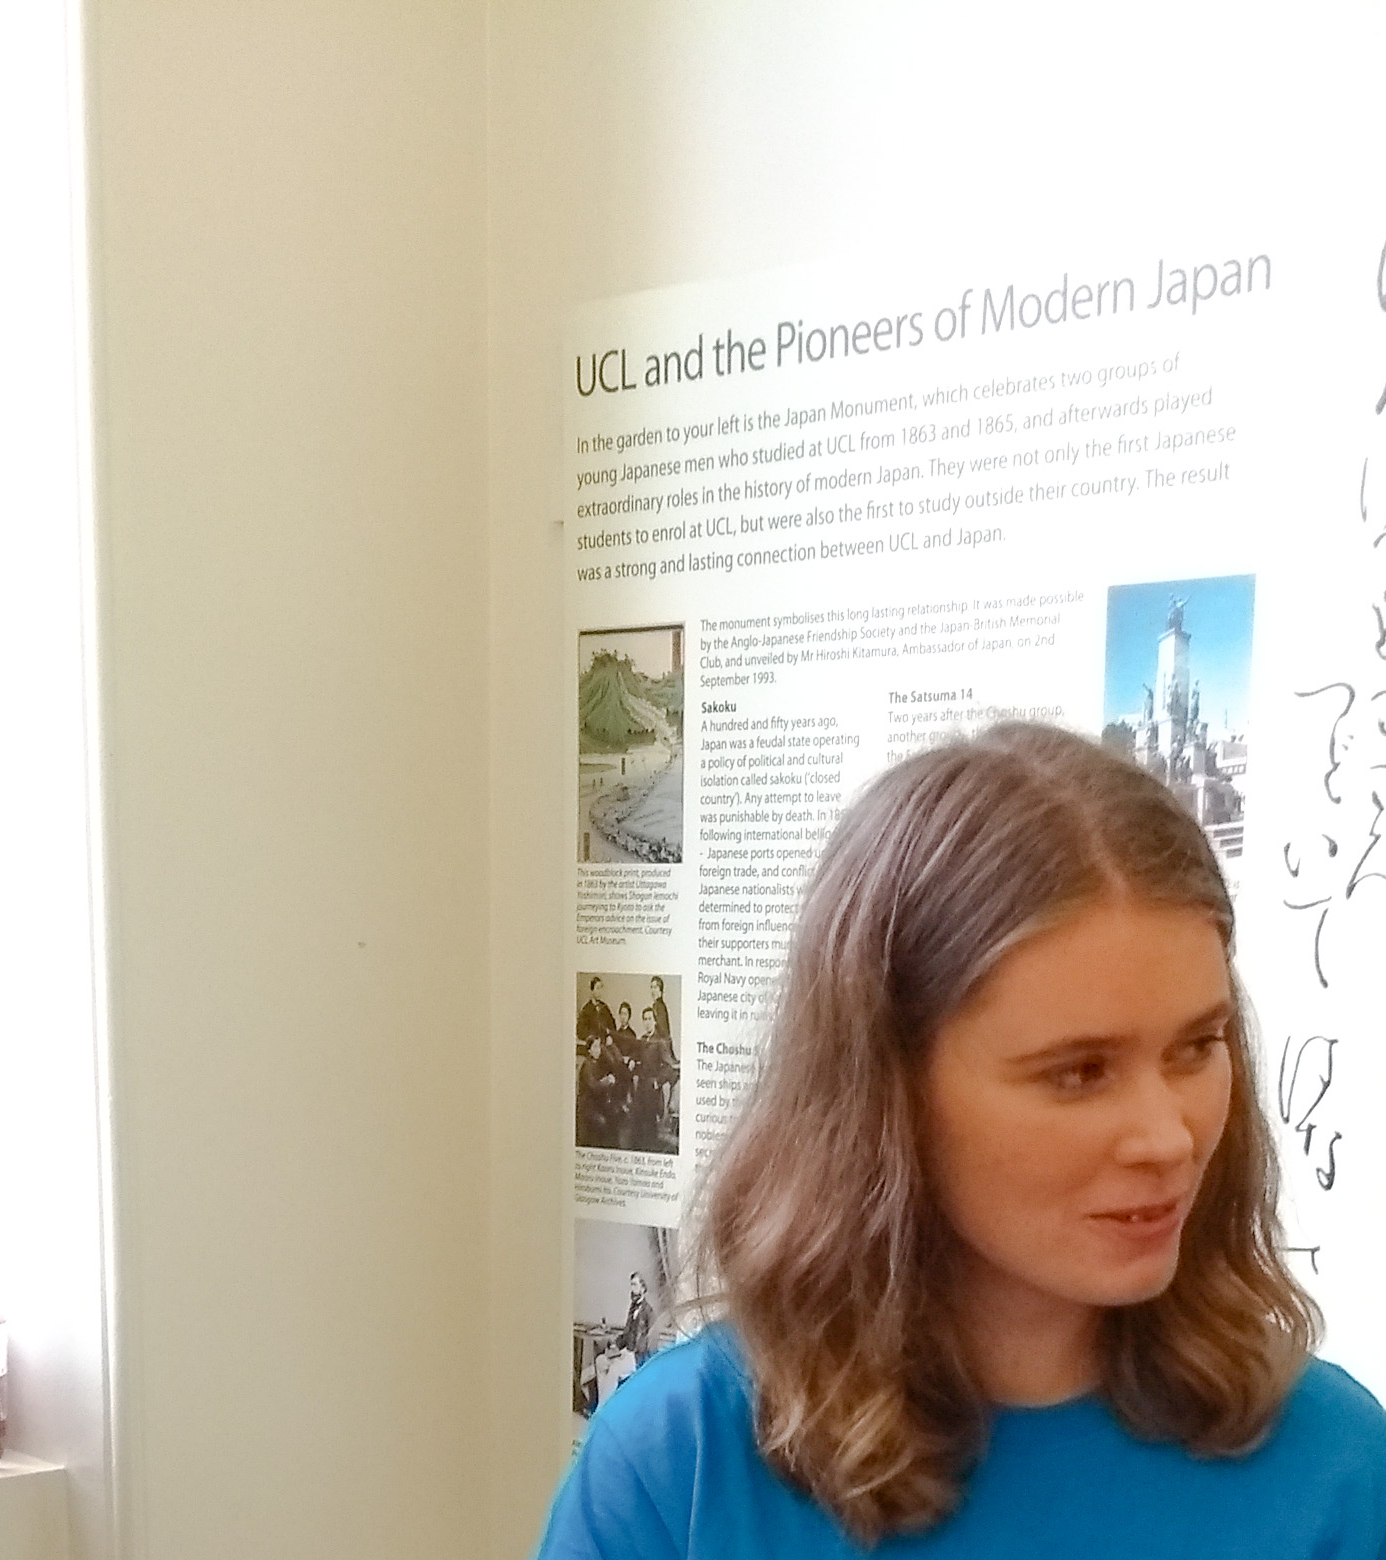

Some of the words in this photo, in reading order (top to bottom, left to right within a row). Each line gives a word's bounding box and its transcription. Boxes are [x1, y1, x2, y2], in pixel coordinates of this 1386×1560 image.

[577, 350, 636, 396] UCL
[645, 335, 703, 387] and
[713, 330, 766, 376] the
[777, 313, 923, 365] Pioneers
[935, 288, 974, 342] of
[982, 275, 1134, 335] Modern
[1148, 255, 1271, 315] Japan
[577, 469, 617, 490] young
[620, 461, 681, 482] Japanese
[685, 457, 714, 473] men
[718, 449, 748, 468] who
[753, 440, 804, 464] studied
[809, 441, 822, 457] at
[827, 434, 855, 455] UCL
[861, 432, 894, 450] from
[902, 424, 936, 445] 1863
[942, 419, 970, 440] and
[979, 413, 1017, 435] 1865,
[1023, 409, 1053, 429] and
[1059, 397, 1148, 425] afterwards
[1154, 388, 1212, 416] played
[577, 567, 601, 581] was
[605, 566, 611, 579] a
[615, 562, 656, 580] strong
[660, 554, 685, 574] and
[689, 553, 733, 572] lasting
[737, 546, 815, 567] connection
[821, 539, 883, 559] between
[889, 532, 918, 552] UCL
[923, 528, 951, 548] and
[957, 528, 1005, 548] Japan.
[700, 673, 749, 689] September
[753, 671, 776, 684] 1993.
[888, 691, 908, 703] The
[911, 691, 956, 703] Satsuma
[961, 687, 973, 700] 14
[702, 701, 736, 713] Sakoku
